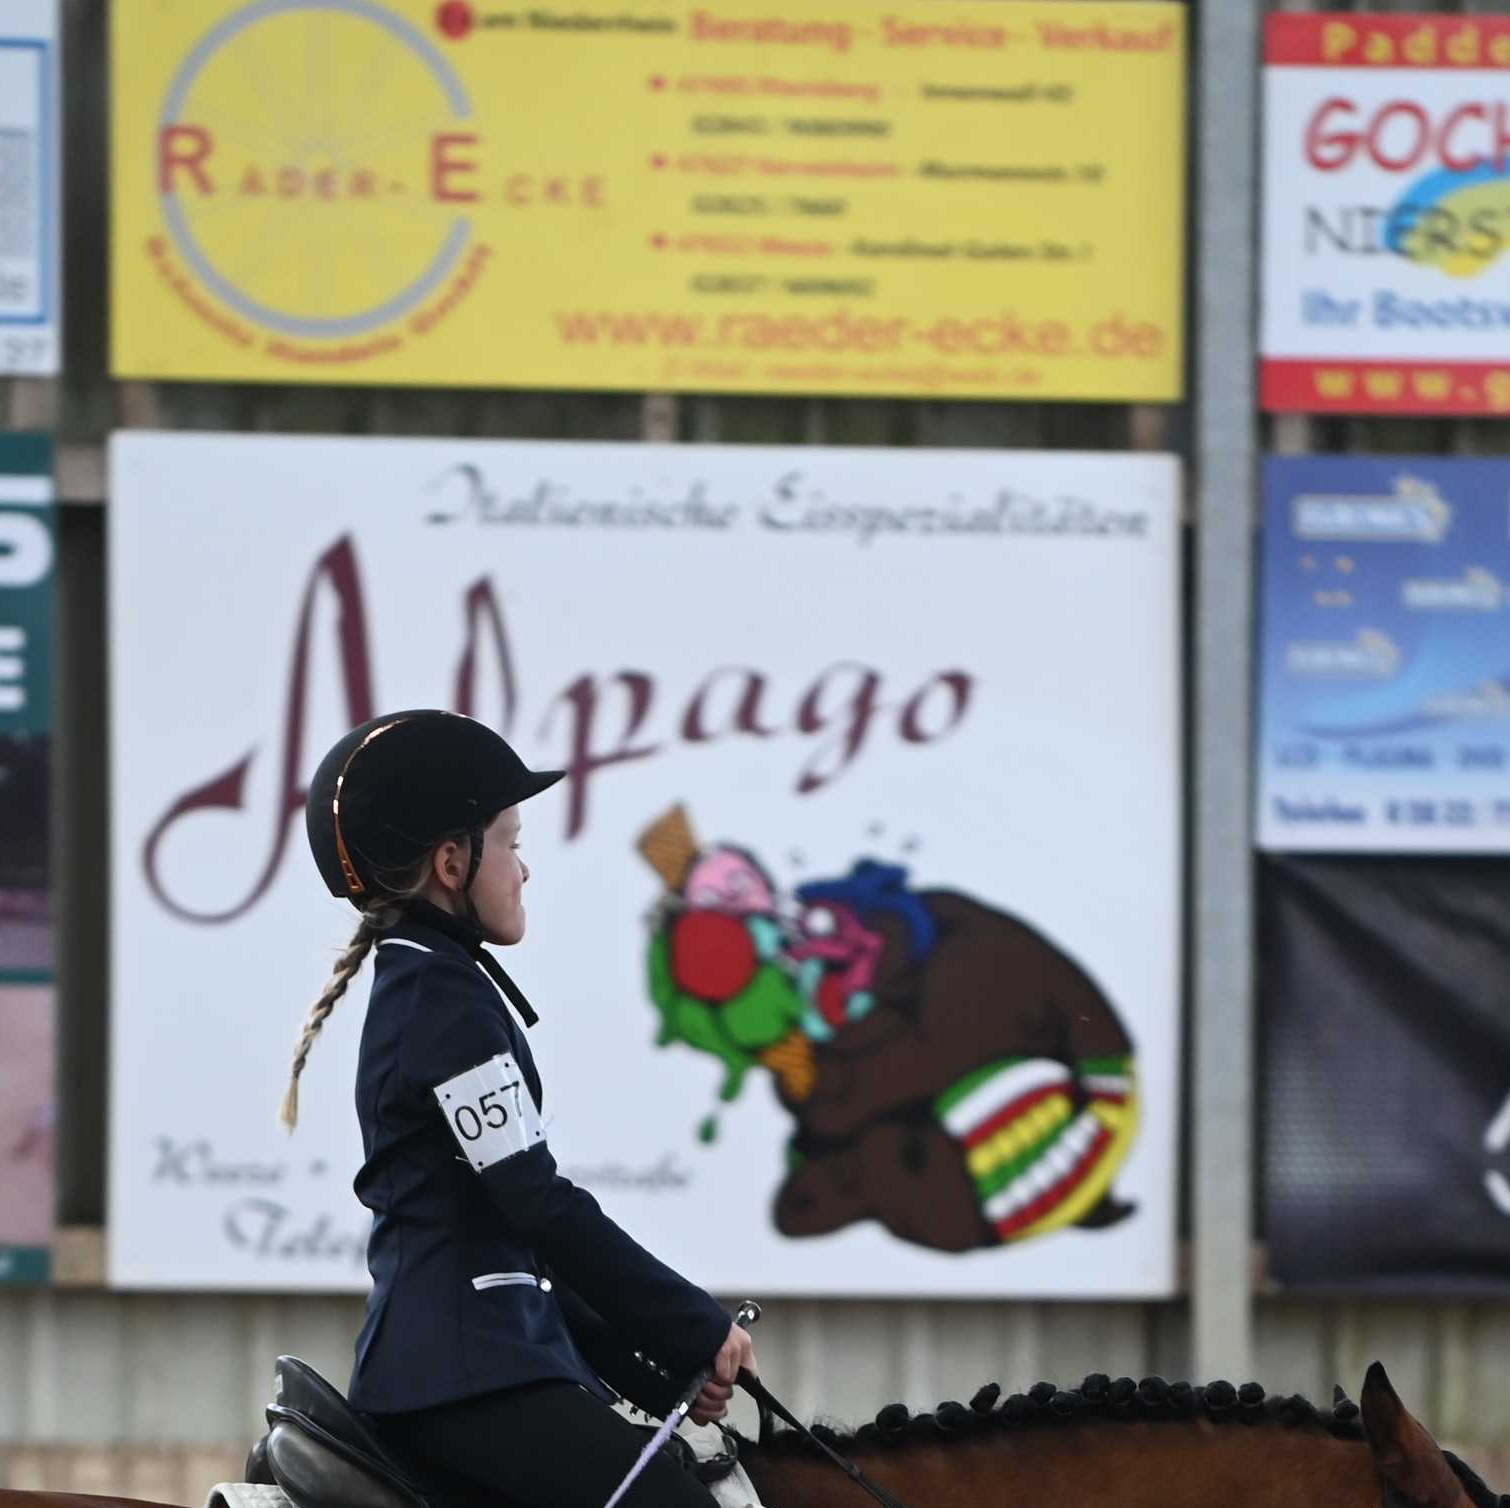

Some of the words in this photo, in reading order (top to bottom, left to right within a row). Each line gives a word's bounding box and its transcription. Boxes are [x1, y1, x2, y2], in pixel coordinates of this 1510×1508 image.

[882, 16, 1006, 49] Service
[1301, 290, 1360, 327] Ihr
[454, 1080, 522, 1141] 057
